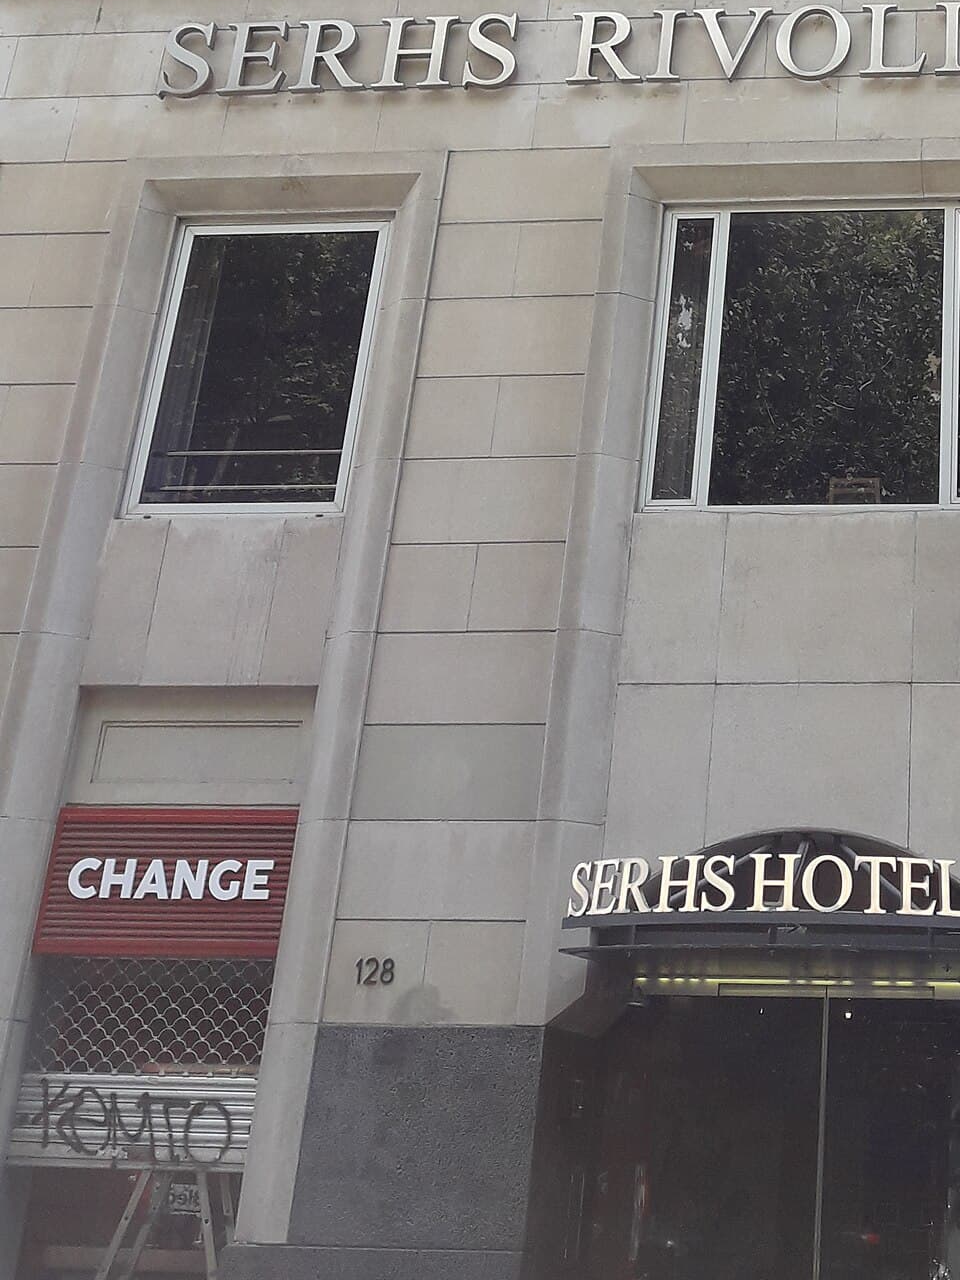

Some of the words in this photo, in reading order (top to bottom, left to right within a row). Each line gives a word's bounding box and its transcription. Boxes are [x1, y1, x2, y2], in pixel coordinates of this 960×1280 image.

[156, 12, 519, 101] SERHS
[67, 857, 276, 901] CHANGE
[567, 854, 737, 919] SERHS
[354, 956, 396, 986] 128
